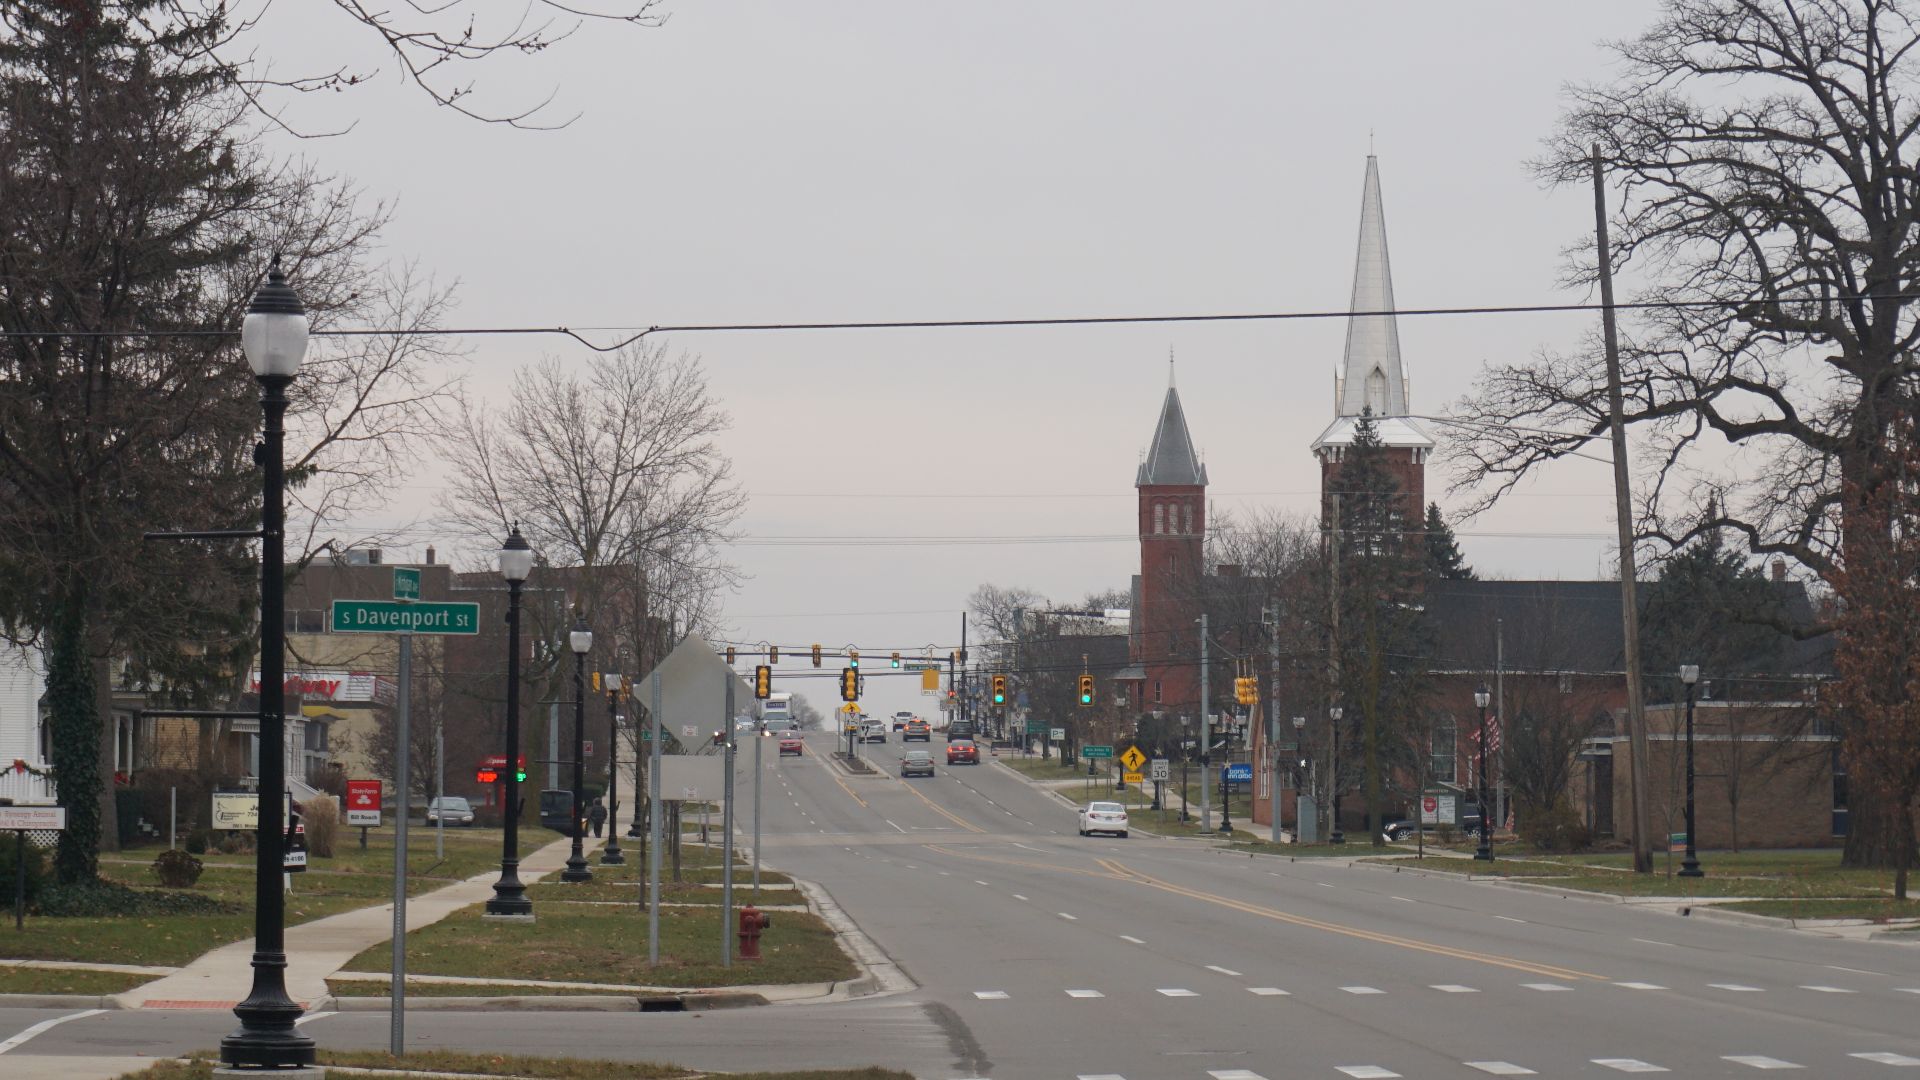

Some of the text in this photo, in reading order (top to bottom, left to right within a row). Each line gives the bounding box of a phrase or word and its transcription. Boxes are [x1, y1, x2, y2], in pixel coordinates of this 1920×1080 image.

[343, 608, 469, 630] S Davenport St
